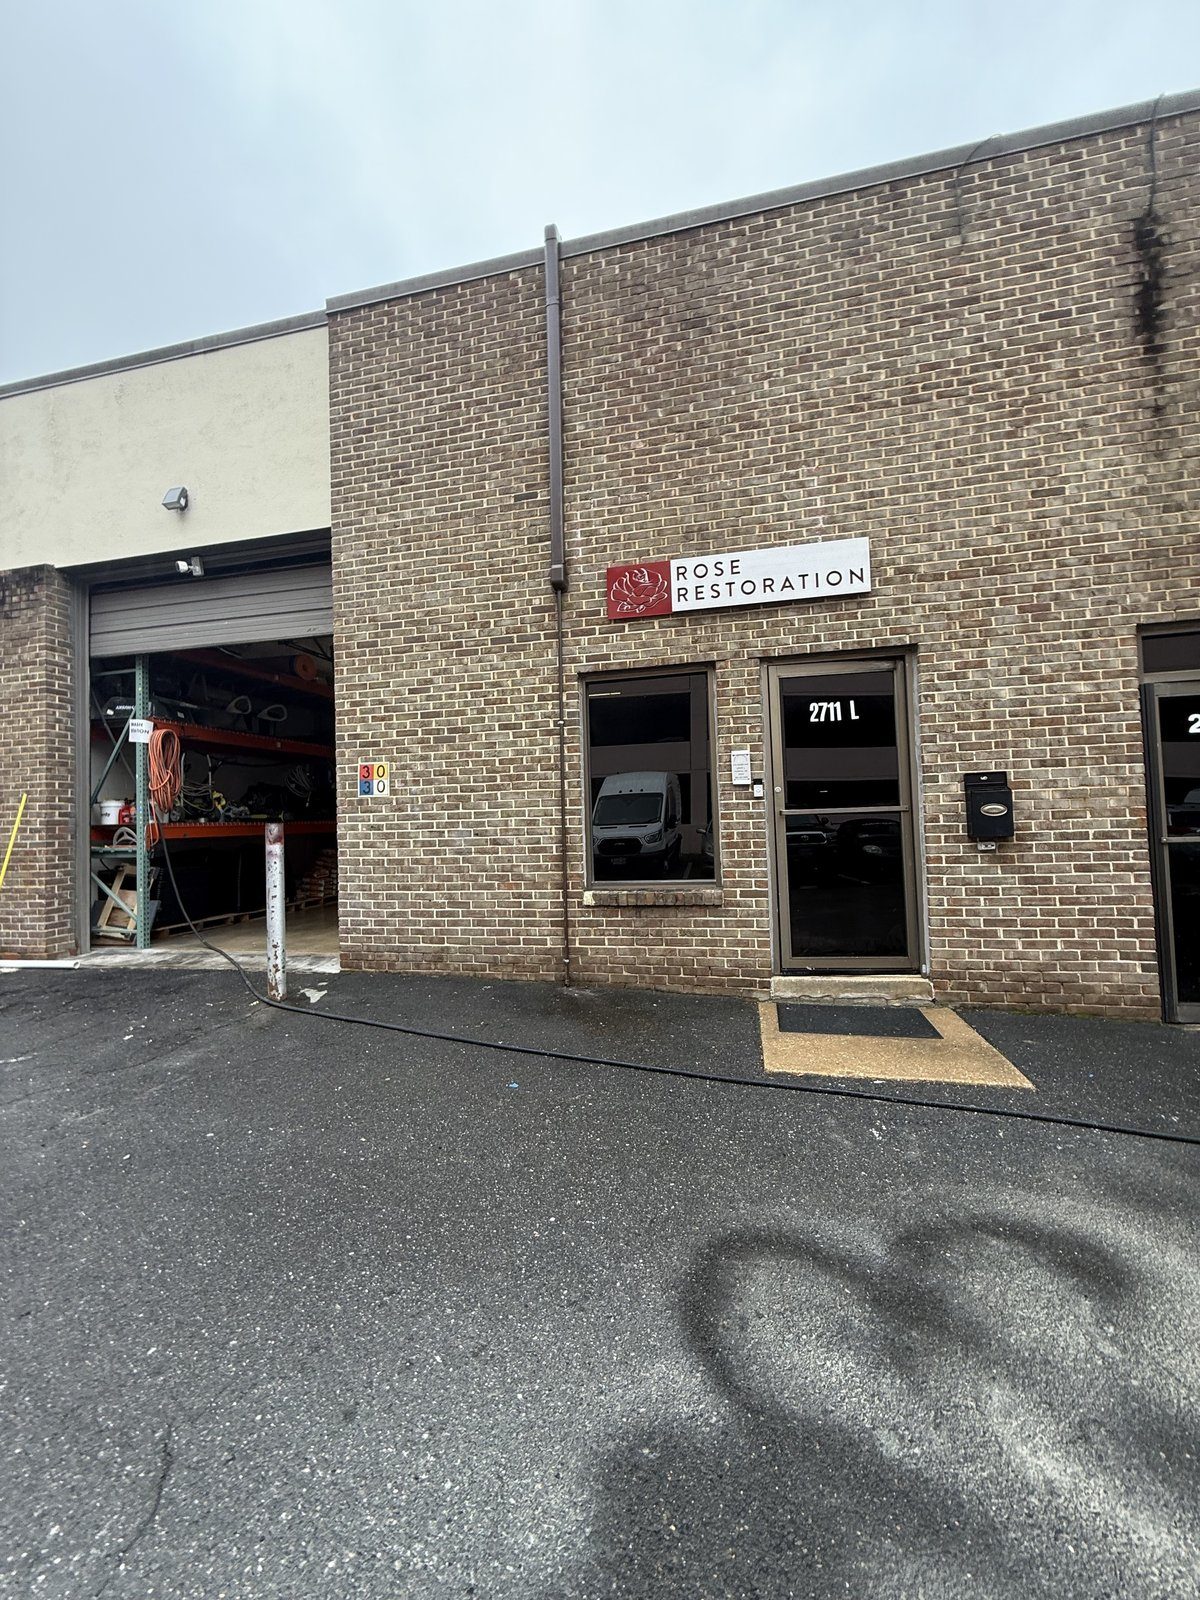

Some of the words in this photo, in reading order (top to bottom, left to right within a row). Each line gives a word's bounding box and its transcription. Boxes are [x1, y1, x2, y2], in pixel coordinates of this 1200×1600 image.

[676, 559, 741, 581] ROSE
[677, 567, 864, 603] RESTORATION
[809, 701, 842, 723] 2711
[849, 699, 860, 720] L
